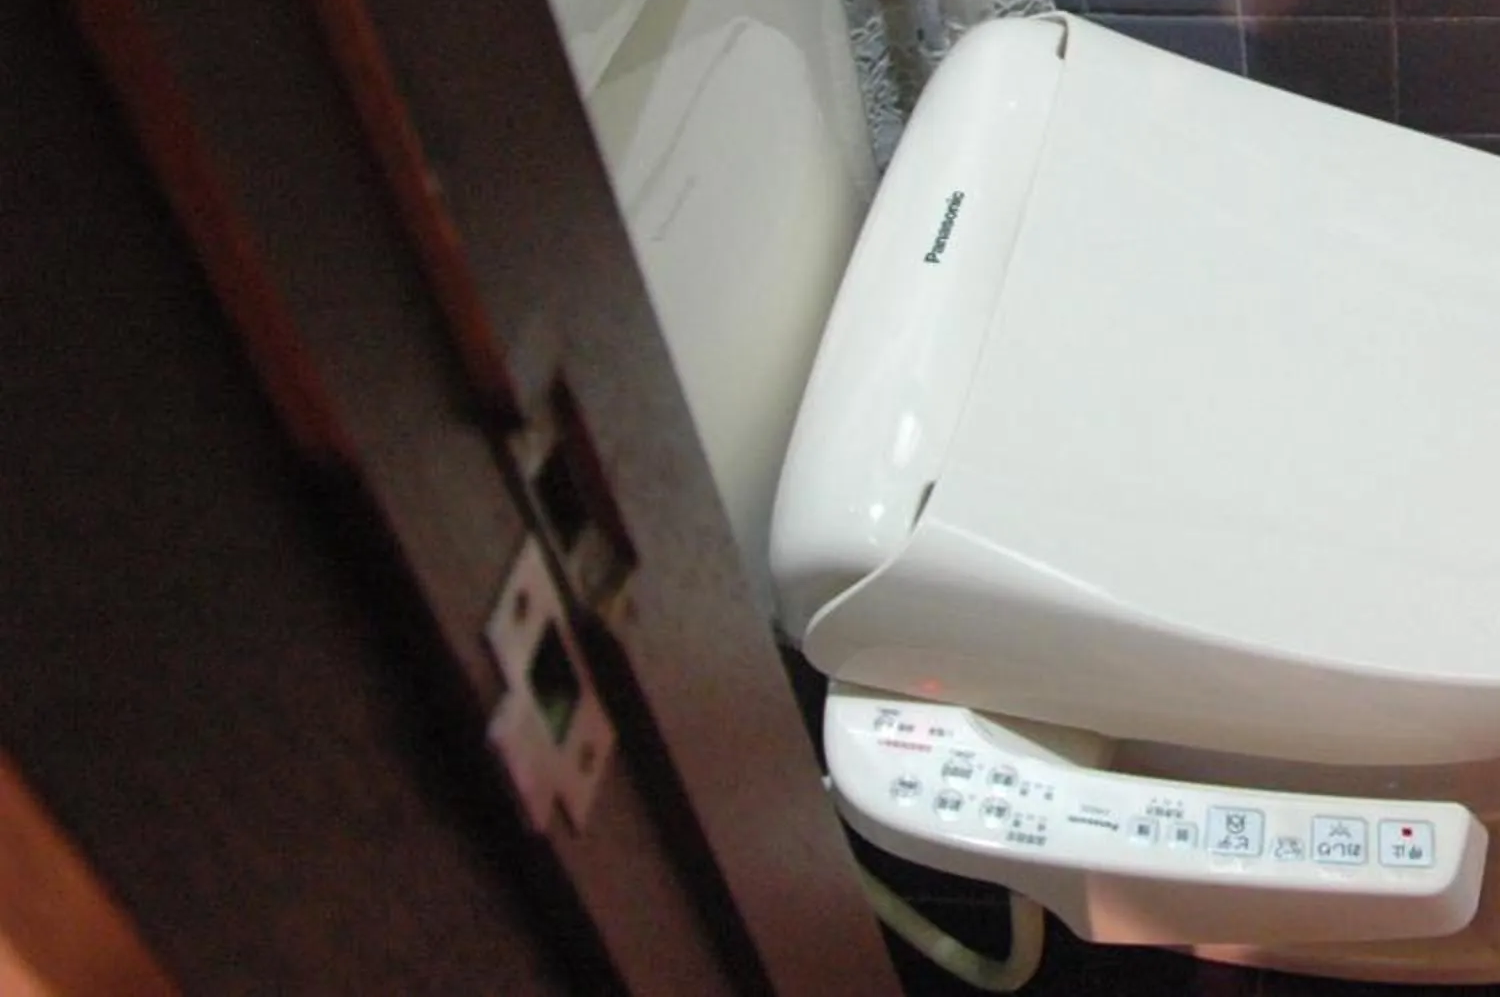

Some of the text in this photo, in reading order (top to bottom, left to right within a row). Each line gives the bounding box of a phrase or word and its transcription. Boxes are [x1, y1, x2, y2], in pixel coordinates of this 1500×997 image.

[923, 190, 965, 263] Panasonic
[1317, 841, 1362, 857] おしり
